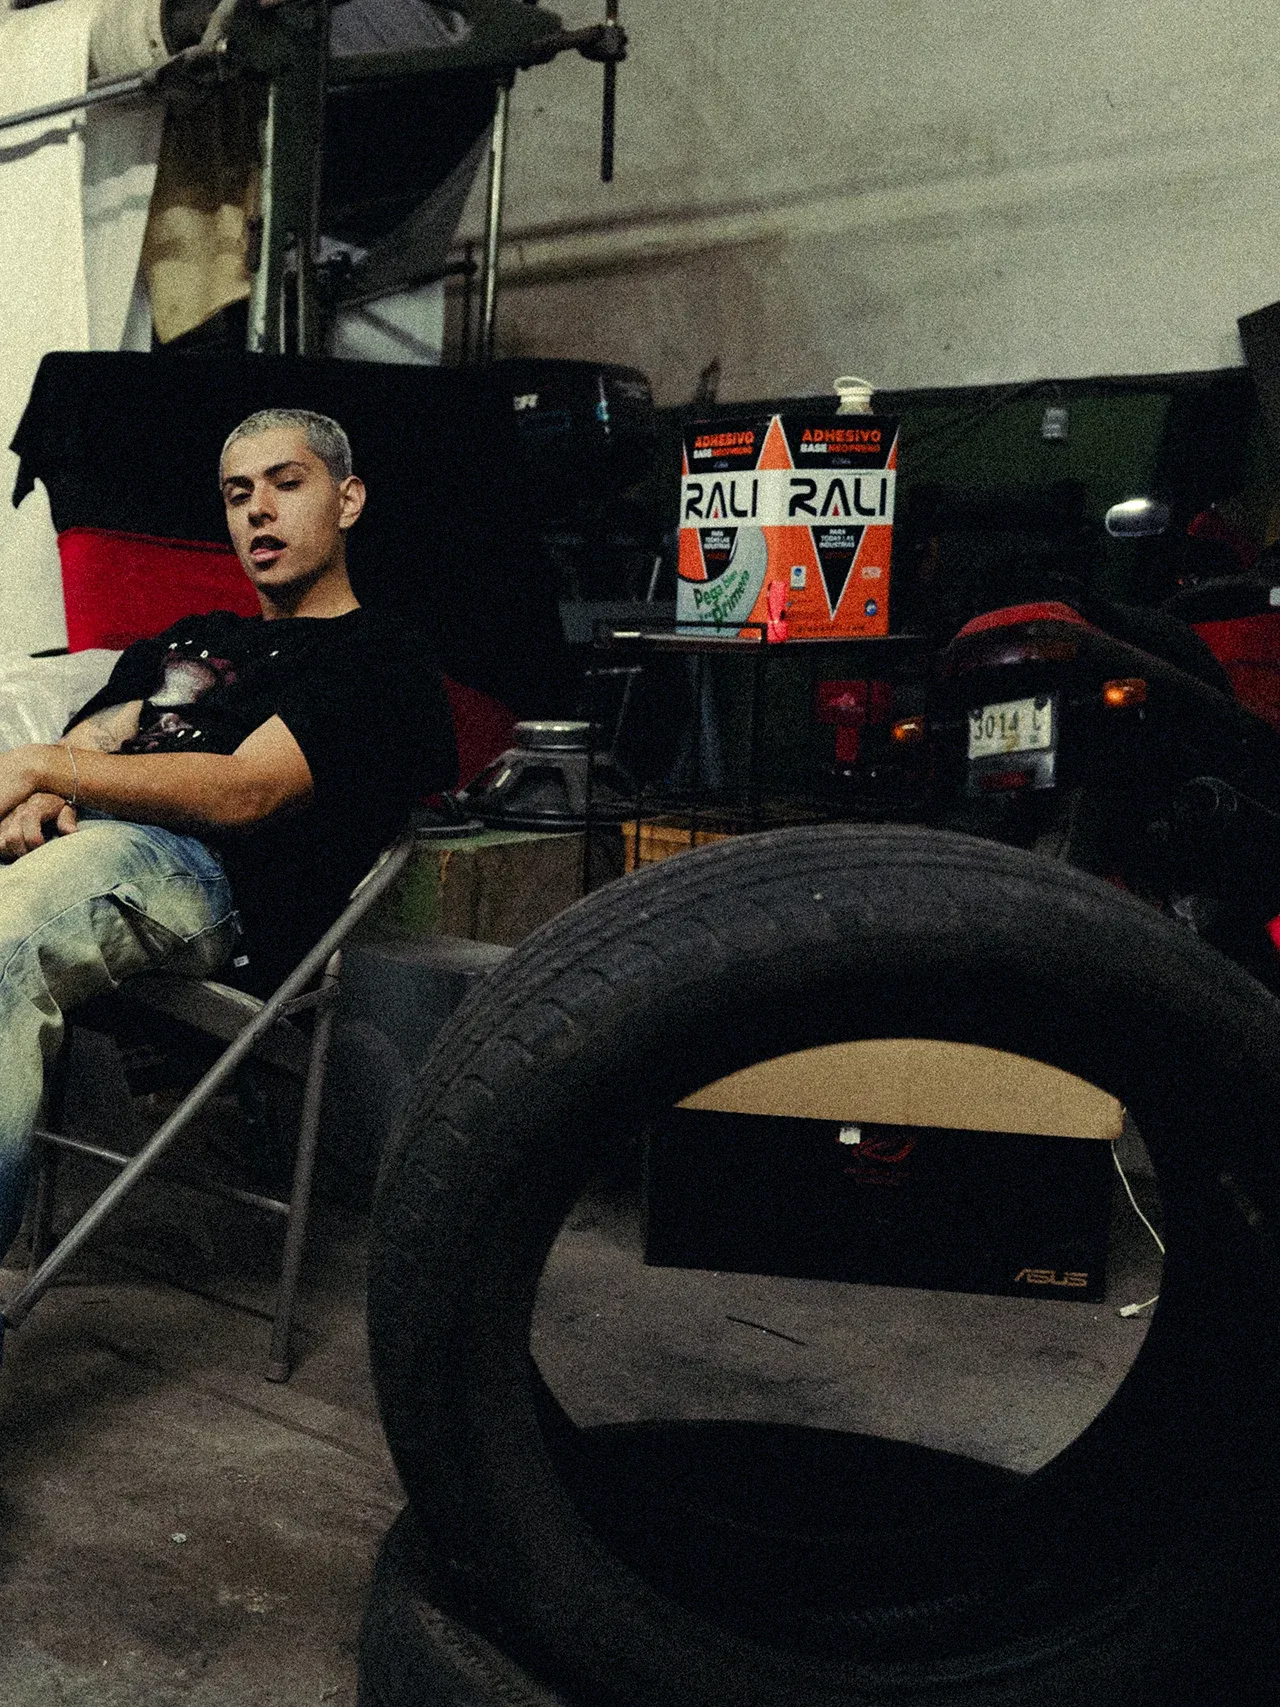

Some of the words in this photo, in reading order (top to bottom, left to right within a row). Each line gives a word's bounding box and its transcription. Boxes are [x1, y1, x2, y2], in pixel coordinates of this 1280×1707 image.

[695, 430, 754, 448] ADHESIVO
[801, 428, 882, 443] ADHESIVO
[800, 443, 828, 453] BASE
[685, 478, 758, 520] RALI
[788, 477, 888, 517] RALI
[1014, 1268, 1089, 1288] ASUS
